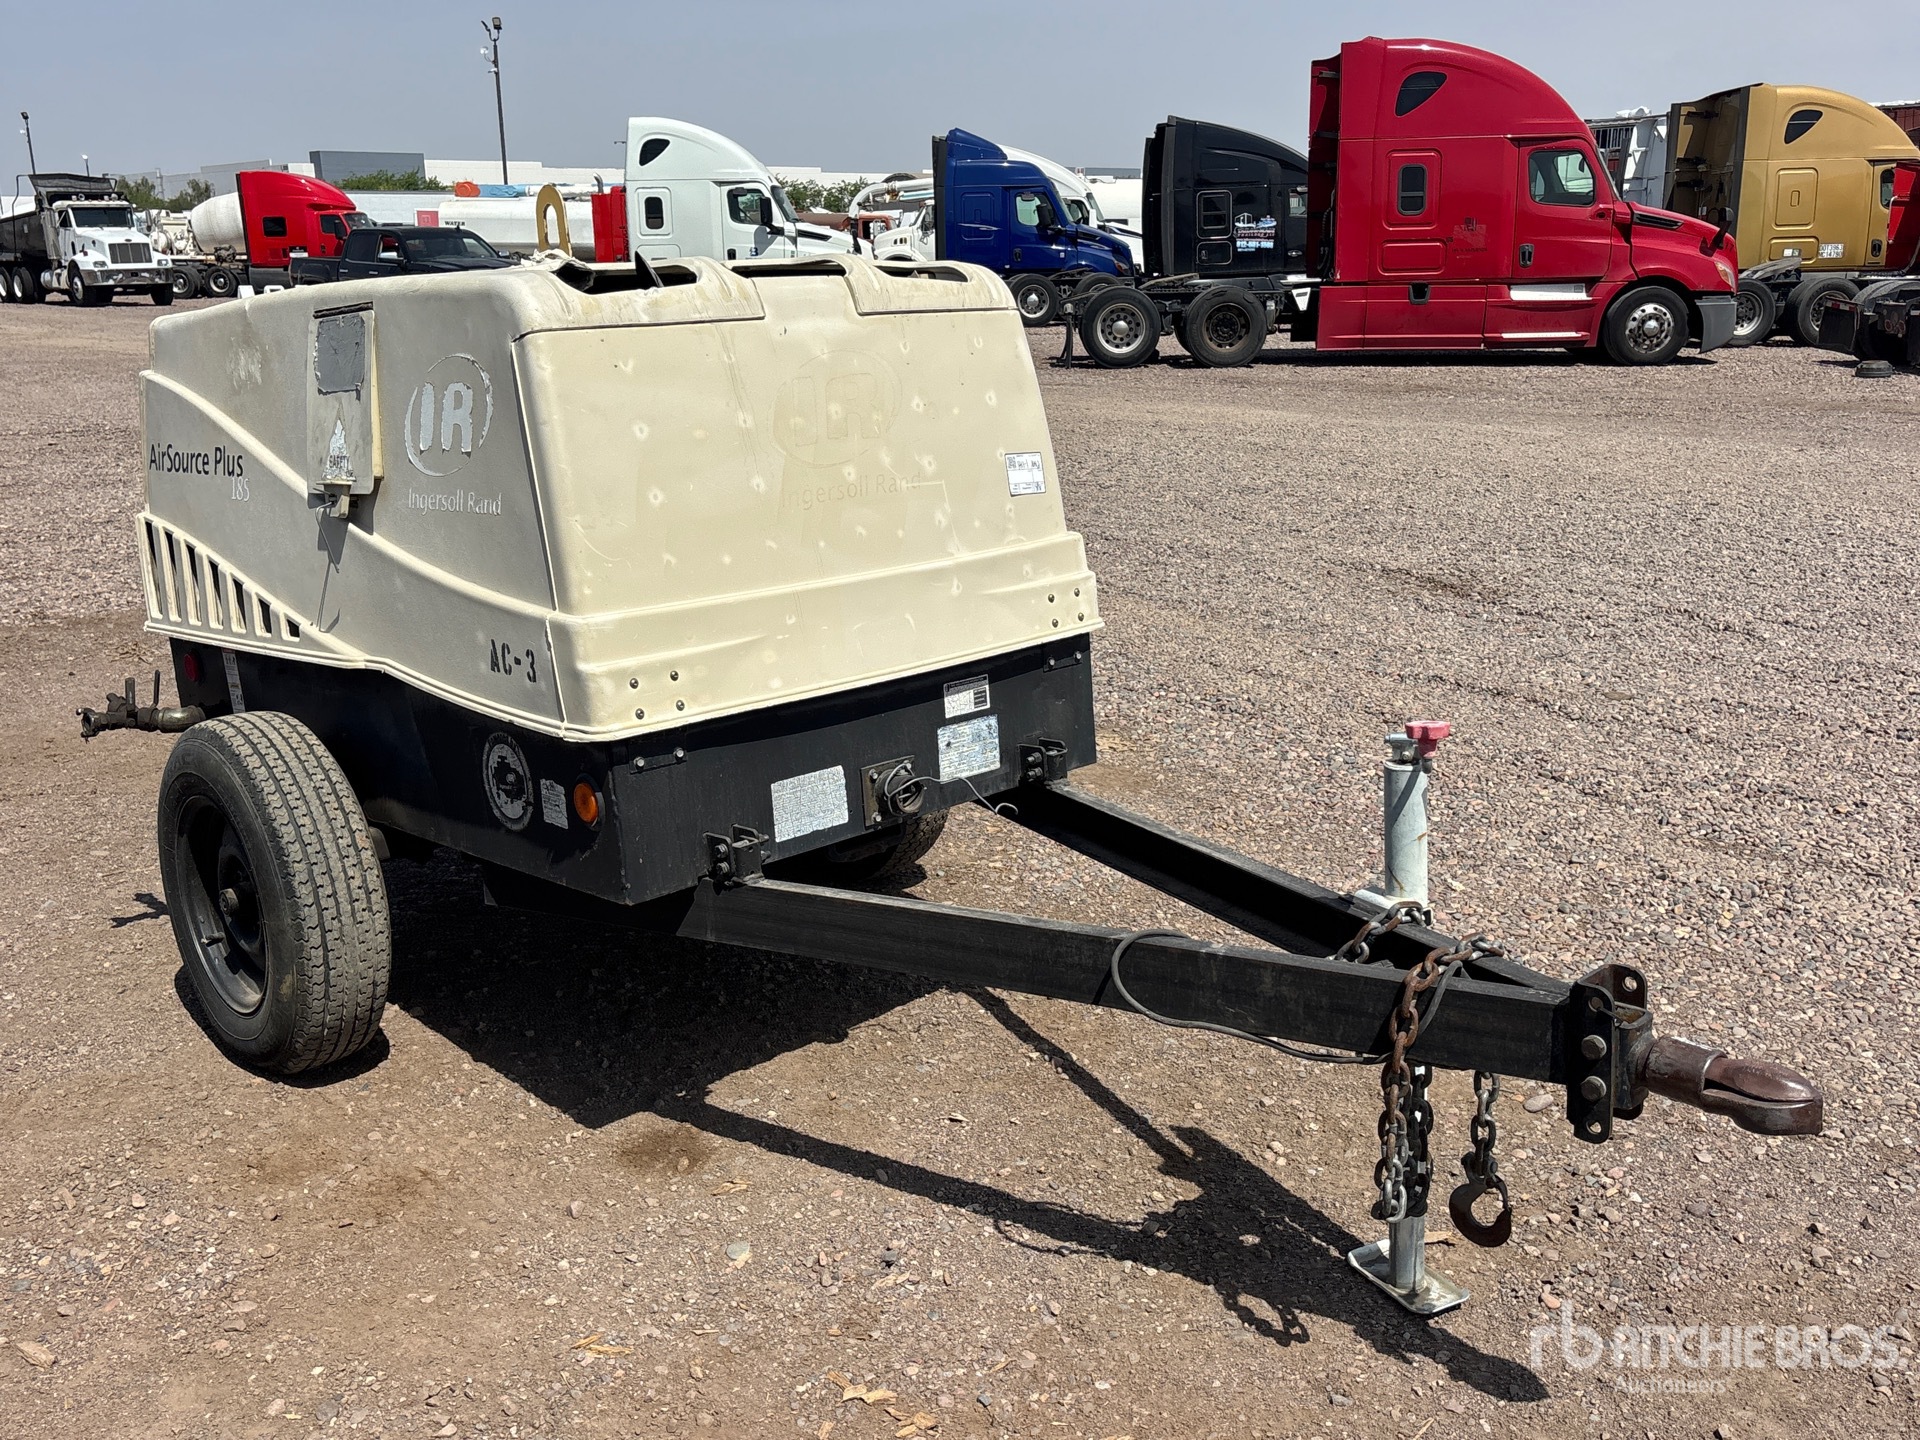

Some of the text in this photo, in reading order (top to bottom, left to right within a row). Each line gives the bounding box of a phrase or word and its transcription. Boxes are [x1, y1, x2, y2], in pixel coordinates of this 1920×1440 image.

[149, 442, 244, 477] AirSource Plus
[231, 476, 250, 502] 185
[874, 471, 921, 494] Rand
[408, 488, 502, 516] Ingersoll Rand
[490, 639, 537, 683] AC-3
